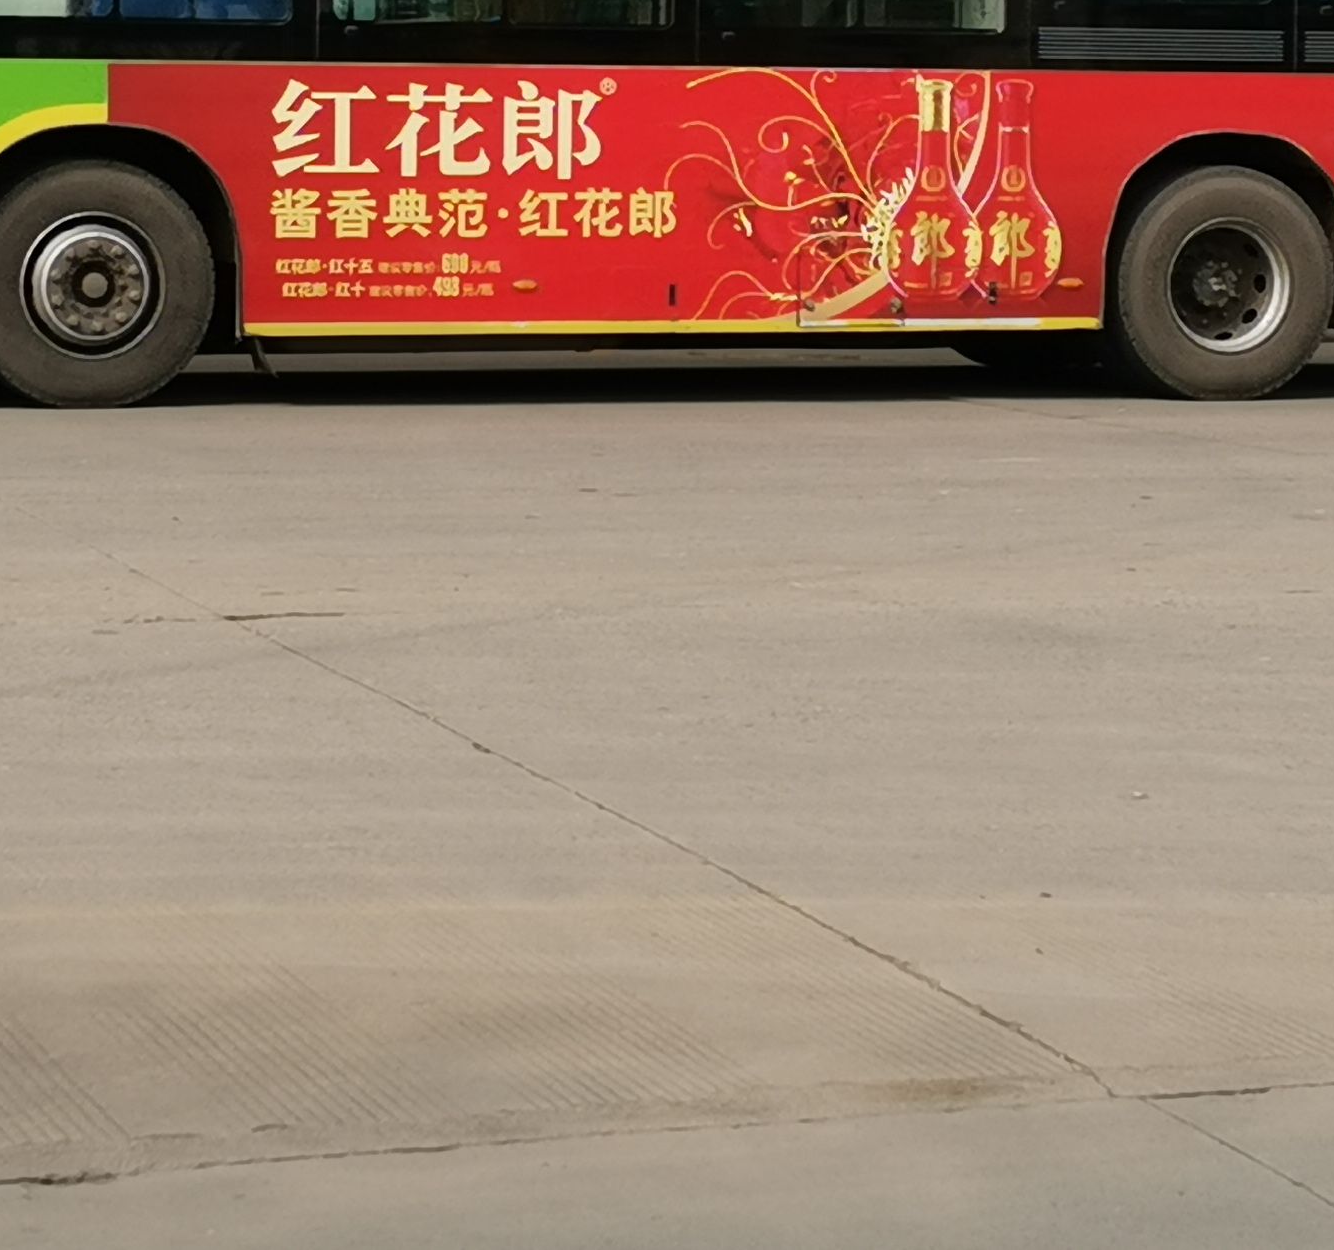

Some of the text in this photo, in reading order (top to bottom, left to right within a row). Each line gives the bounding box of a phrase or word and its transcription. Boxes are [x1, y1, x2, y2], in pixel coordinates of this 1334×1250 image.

[270, 79, 603, 180] 红花郎
[269, 187, 677, 239] 酱香典范·红花郎
